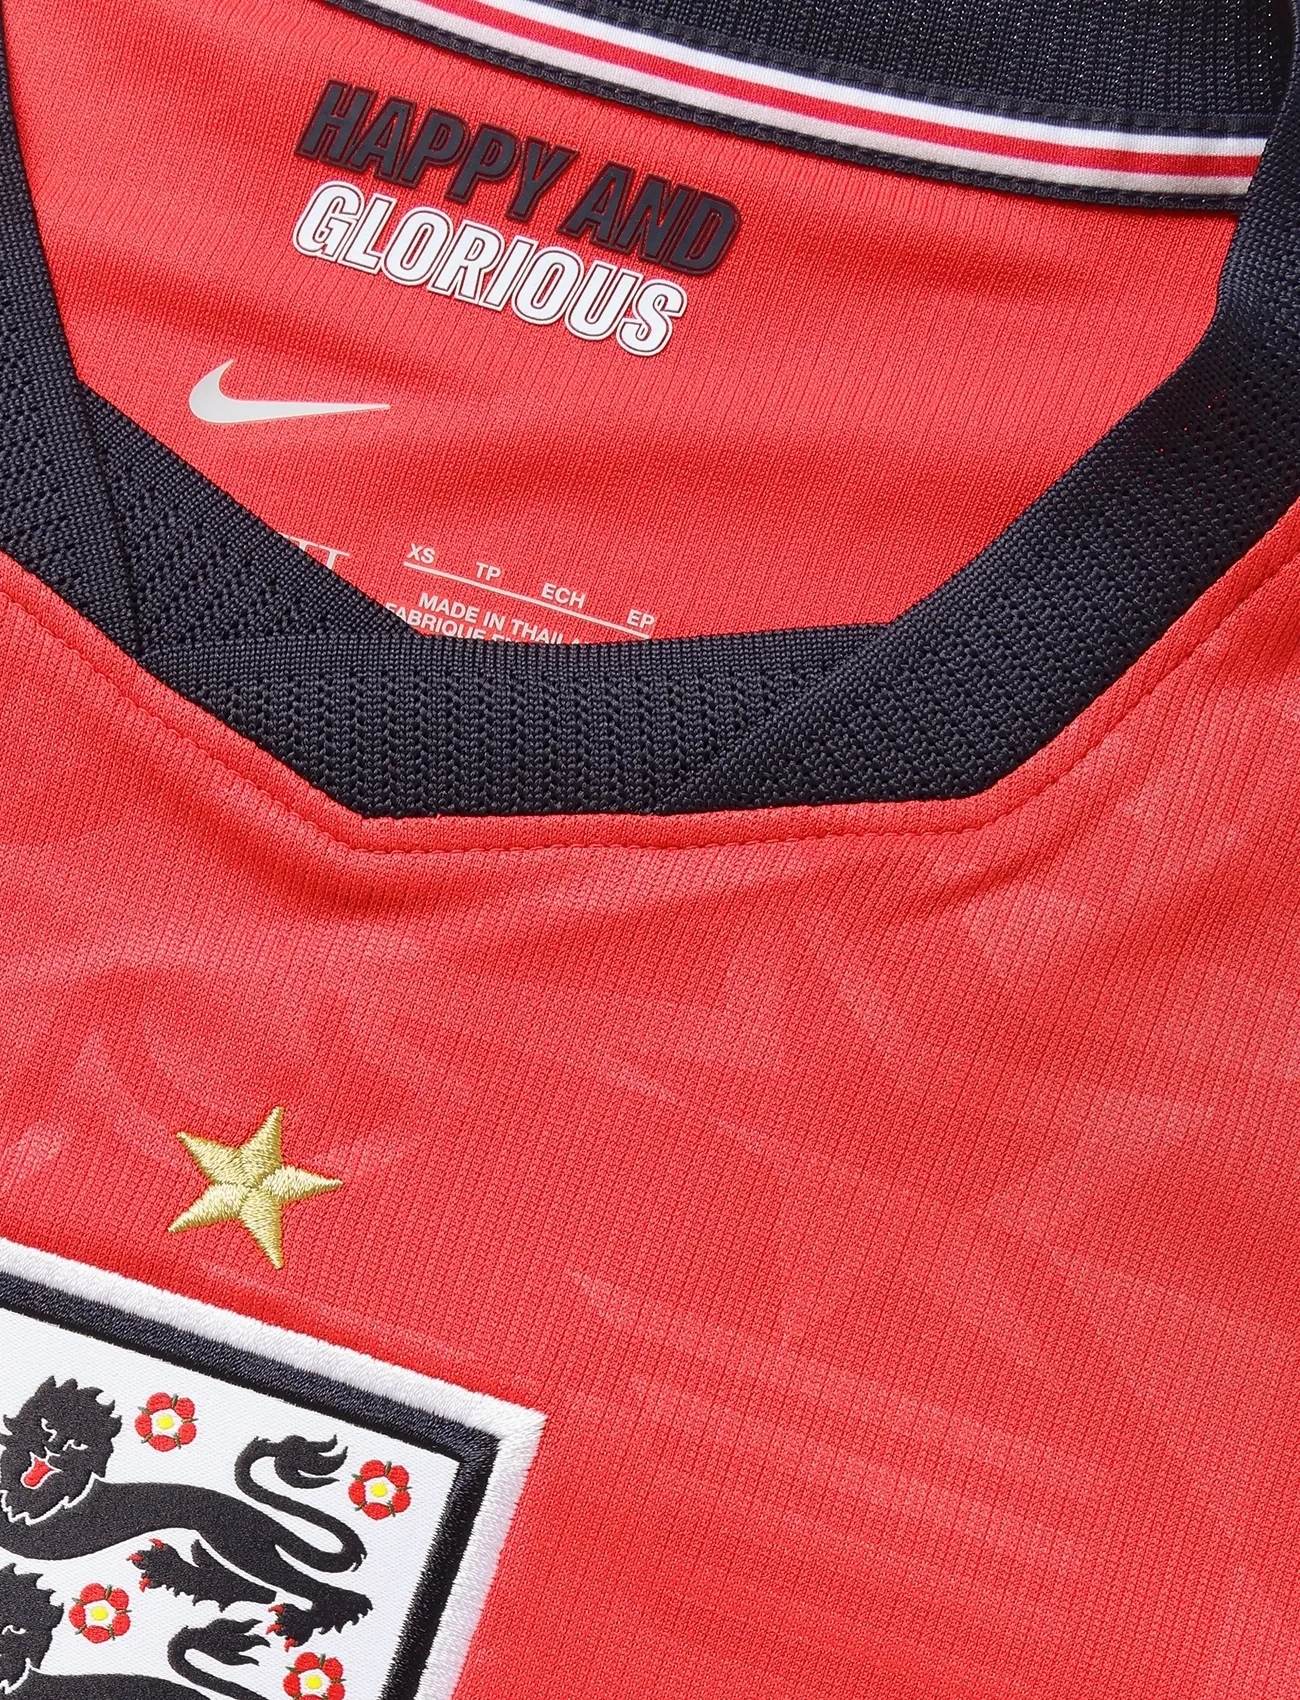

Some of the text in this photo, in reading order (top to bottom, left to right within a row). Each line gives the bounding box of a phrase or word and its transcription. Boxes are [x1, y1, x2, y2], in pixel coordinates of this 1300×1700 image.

[295, 79, 742, 275] HAPPY AND
[293, 181, 688, 357] GLORIOUS
[406, 543, 655, 631] XS TP ECH EP
[418, 592, 481, 624] MADE
[482, 611, 506, 631] IN
